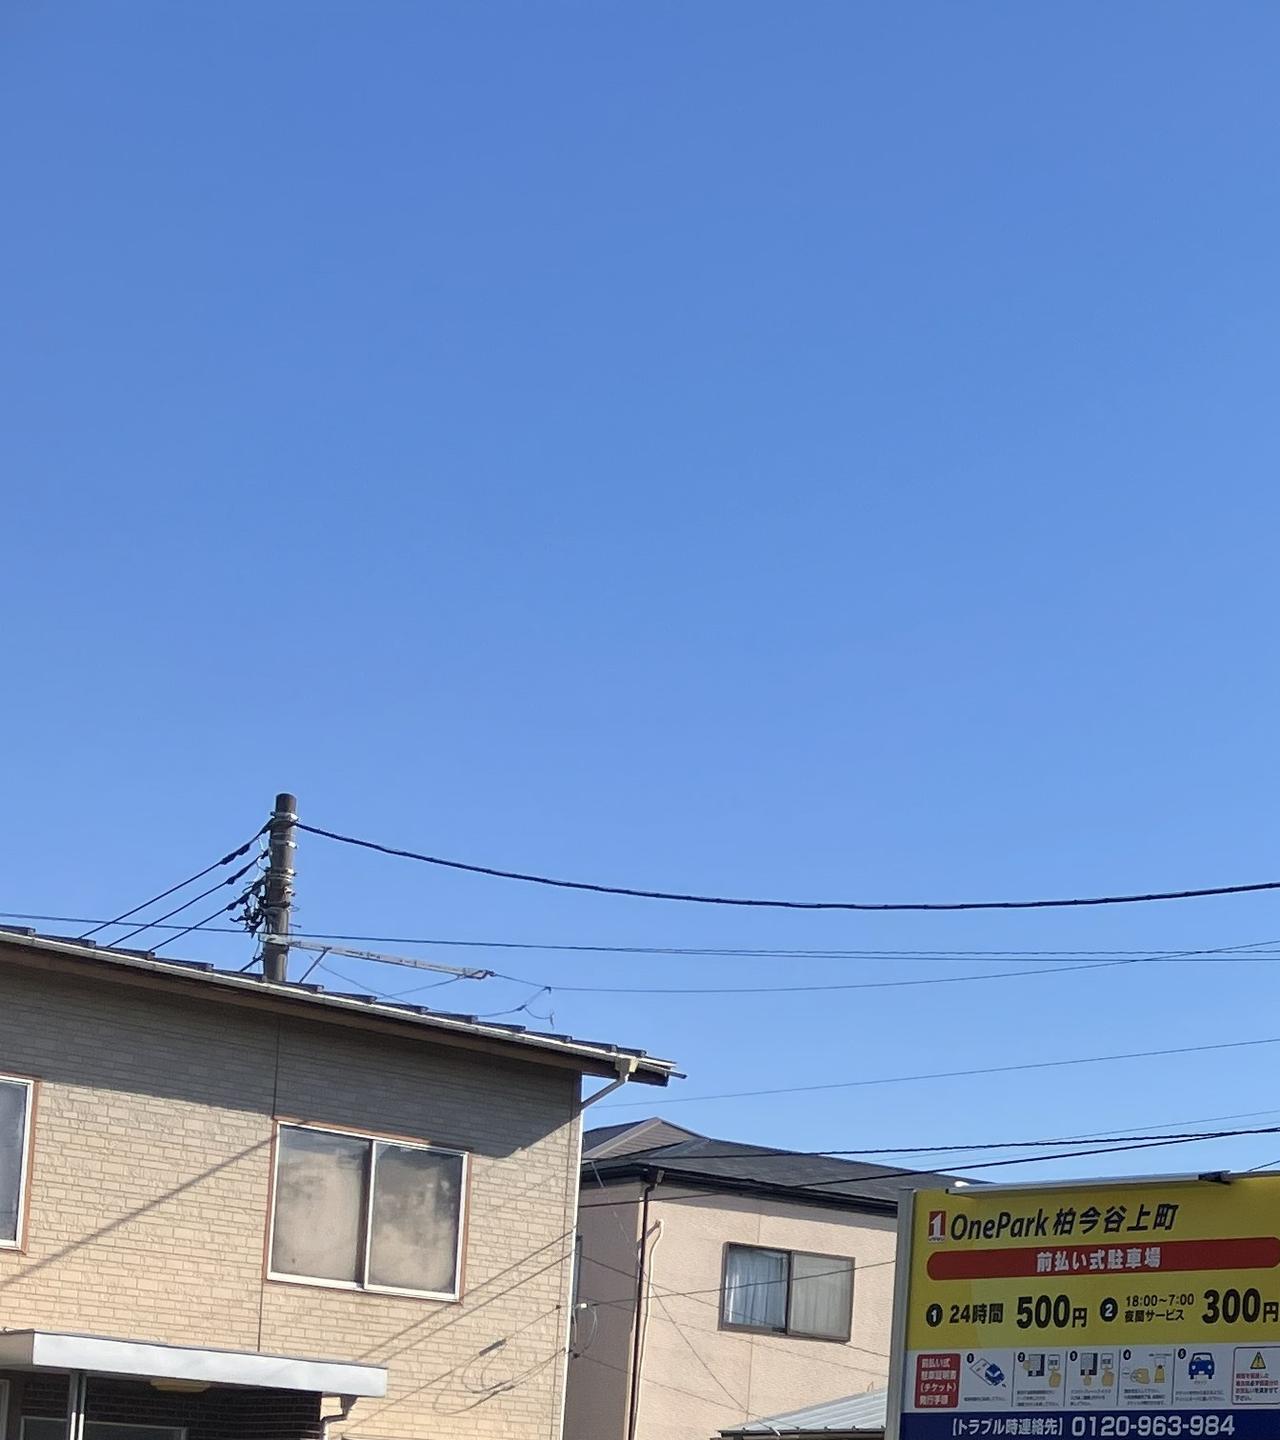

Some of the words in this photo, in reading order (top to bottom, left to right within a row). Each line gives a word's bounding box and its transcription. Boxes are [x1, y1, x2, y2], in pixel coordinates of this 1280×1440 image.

[951, 1208, 1049, 1240] OnePark
[1053, 1203, 1179, 1236] 柏今谷上町
[1037, 1247, 1161, 1273] 前払い式駐車場
[949, 1303, 1004, 1324] 24時間
[1016, 1295, 1087, 1329] 500円
[1124, 1309, 1185, 1323] 夜間サービス
[1201, 1288, 1279, 1324] 300円
[1071, 1414, 1235, 1436] 0120-963-984
